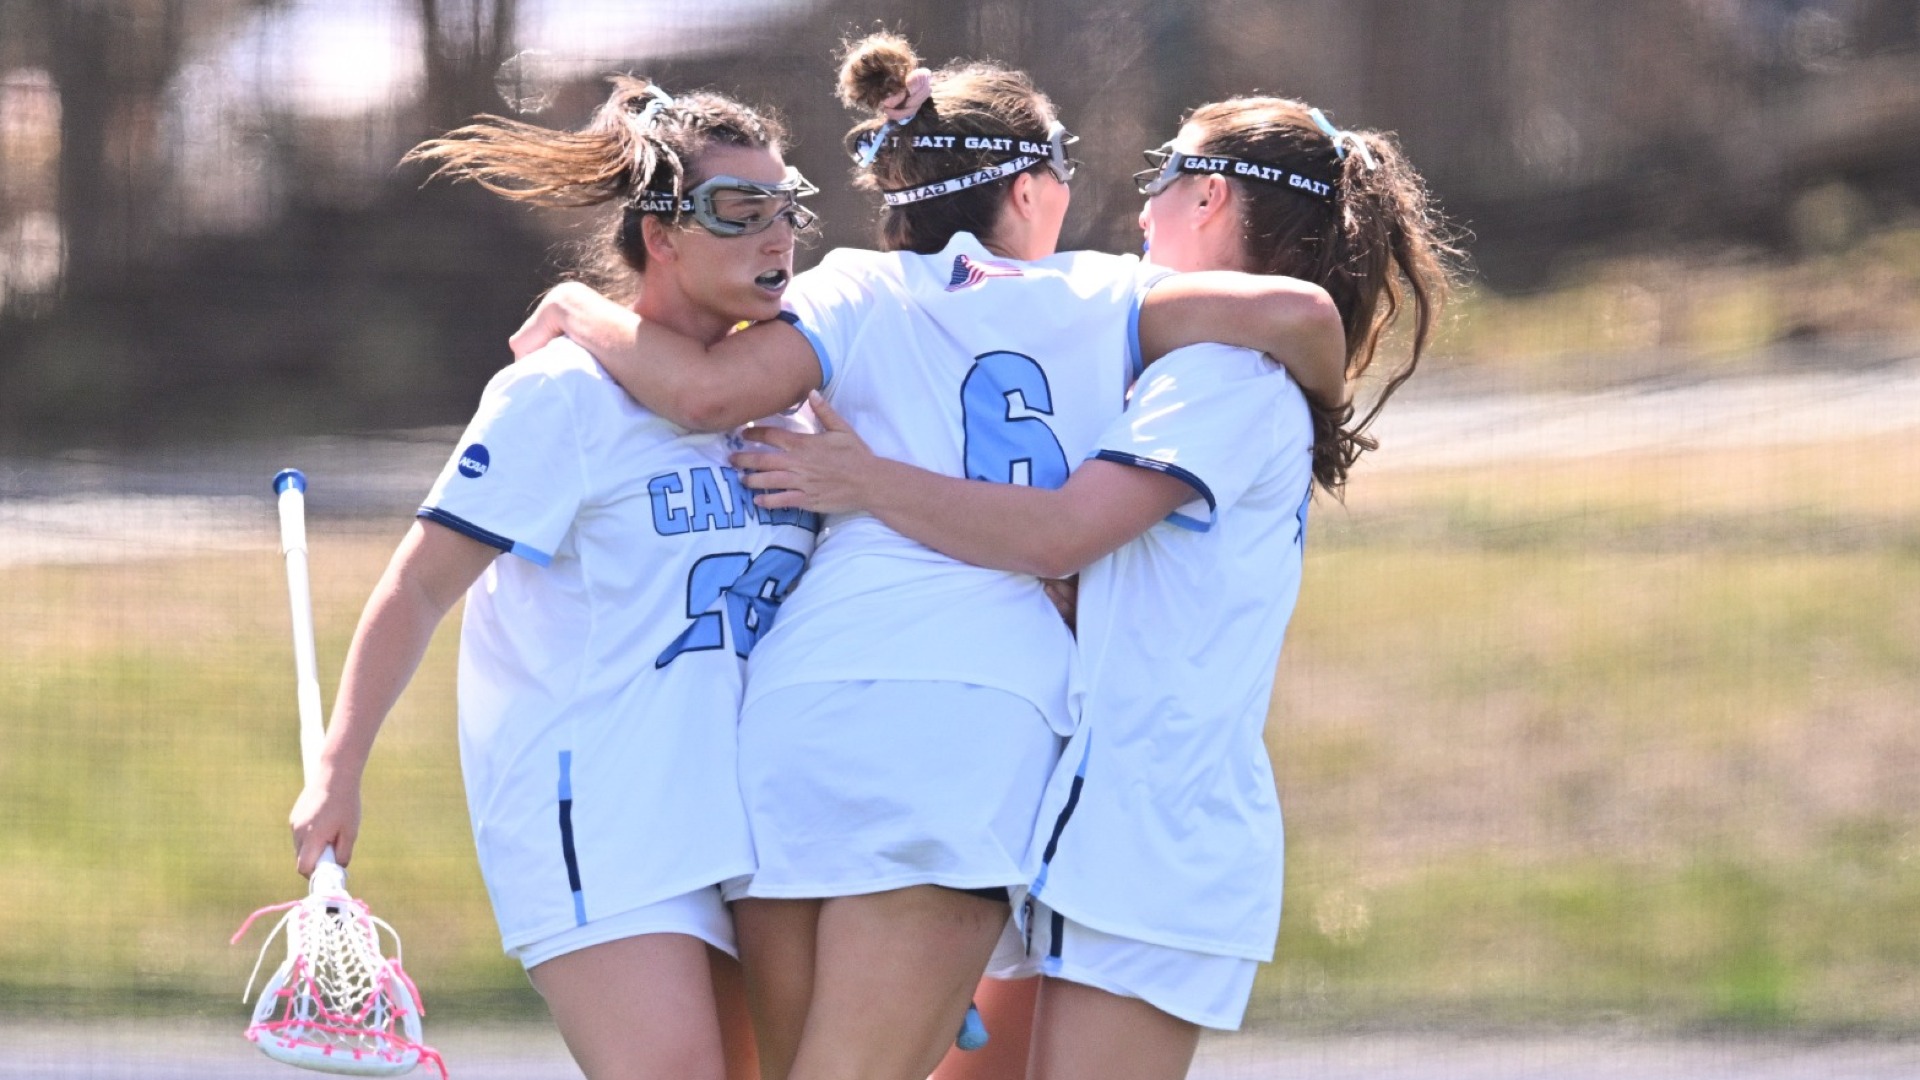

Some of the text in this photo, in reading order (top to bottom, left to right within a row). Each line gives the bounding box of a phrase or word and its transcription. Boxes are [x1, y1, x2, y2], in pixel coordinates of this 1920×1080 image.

[965, 136, 1013, 151] GAIT
[1184, 157, 1330, 197] GAIT GAIT GAIT
[640, 199, 673, 212] GAIT
[960, 350, 1070, 491] 6
[460, 456, 488, 474] NCAA
[655, 545, 806, 670] 26
